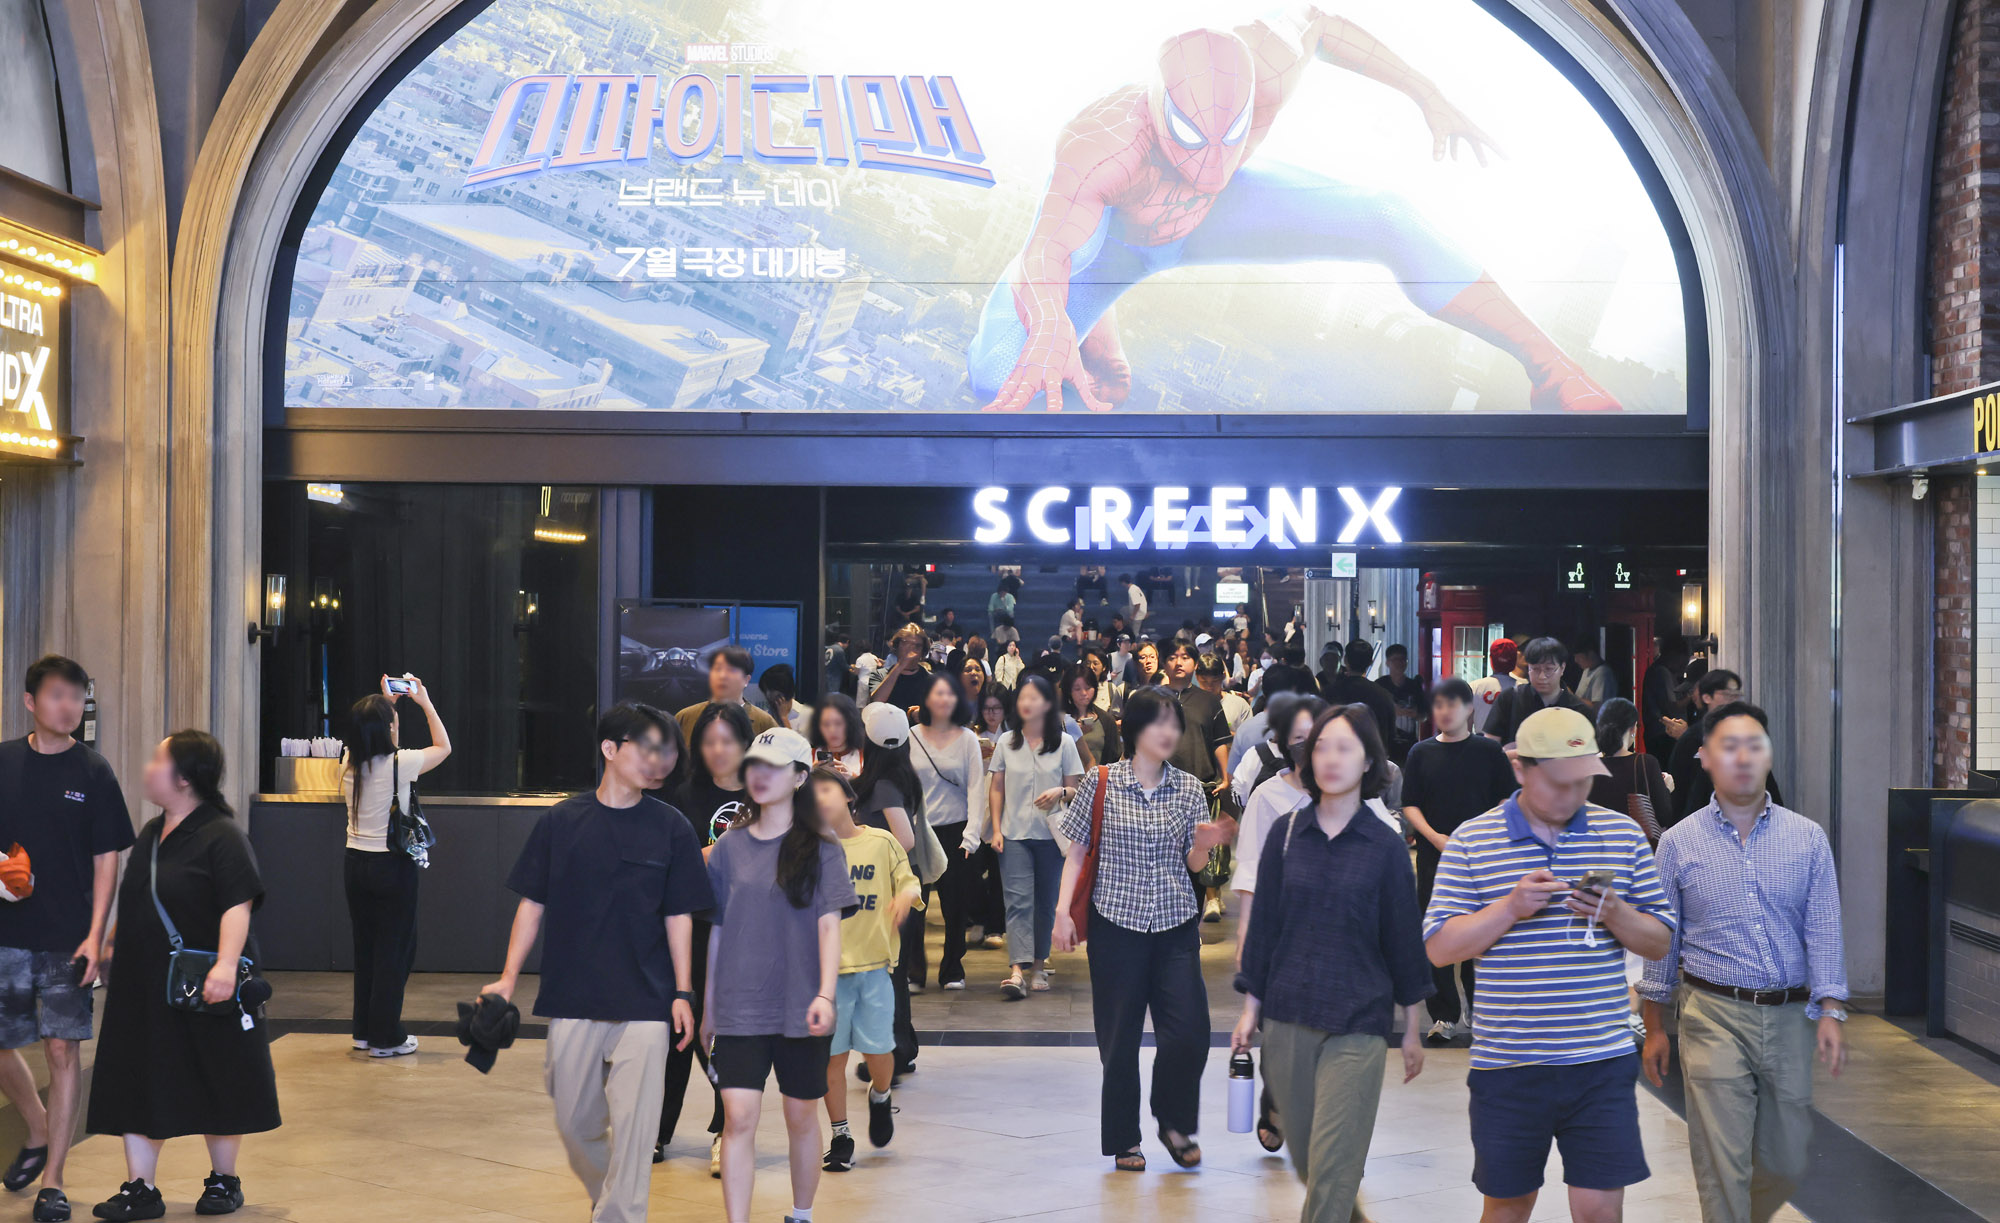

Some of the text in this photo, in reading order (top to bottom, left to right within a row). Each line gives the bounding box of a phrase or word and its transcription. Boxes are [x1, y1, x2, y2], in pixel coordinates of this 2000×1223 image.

[686, 44, 730, 62] MARVEL
[463, 73, 996, 188] 스파이더맨
[617, 178, 841, 207] 브랜드 뉴 데이
[614, 246, 846, 278] 7월 극장 대개봉
[1973, 393, 2000, 454] PO
[753, 643, 789, 657] Store
